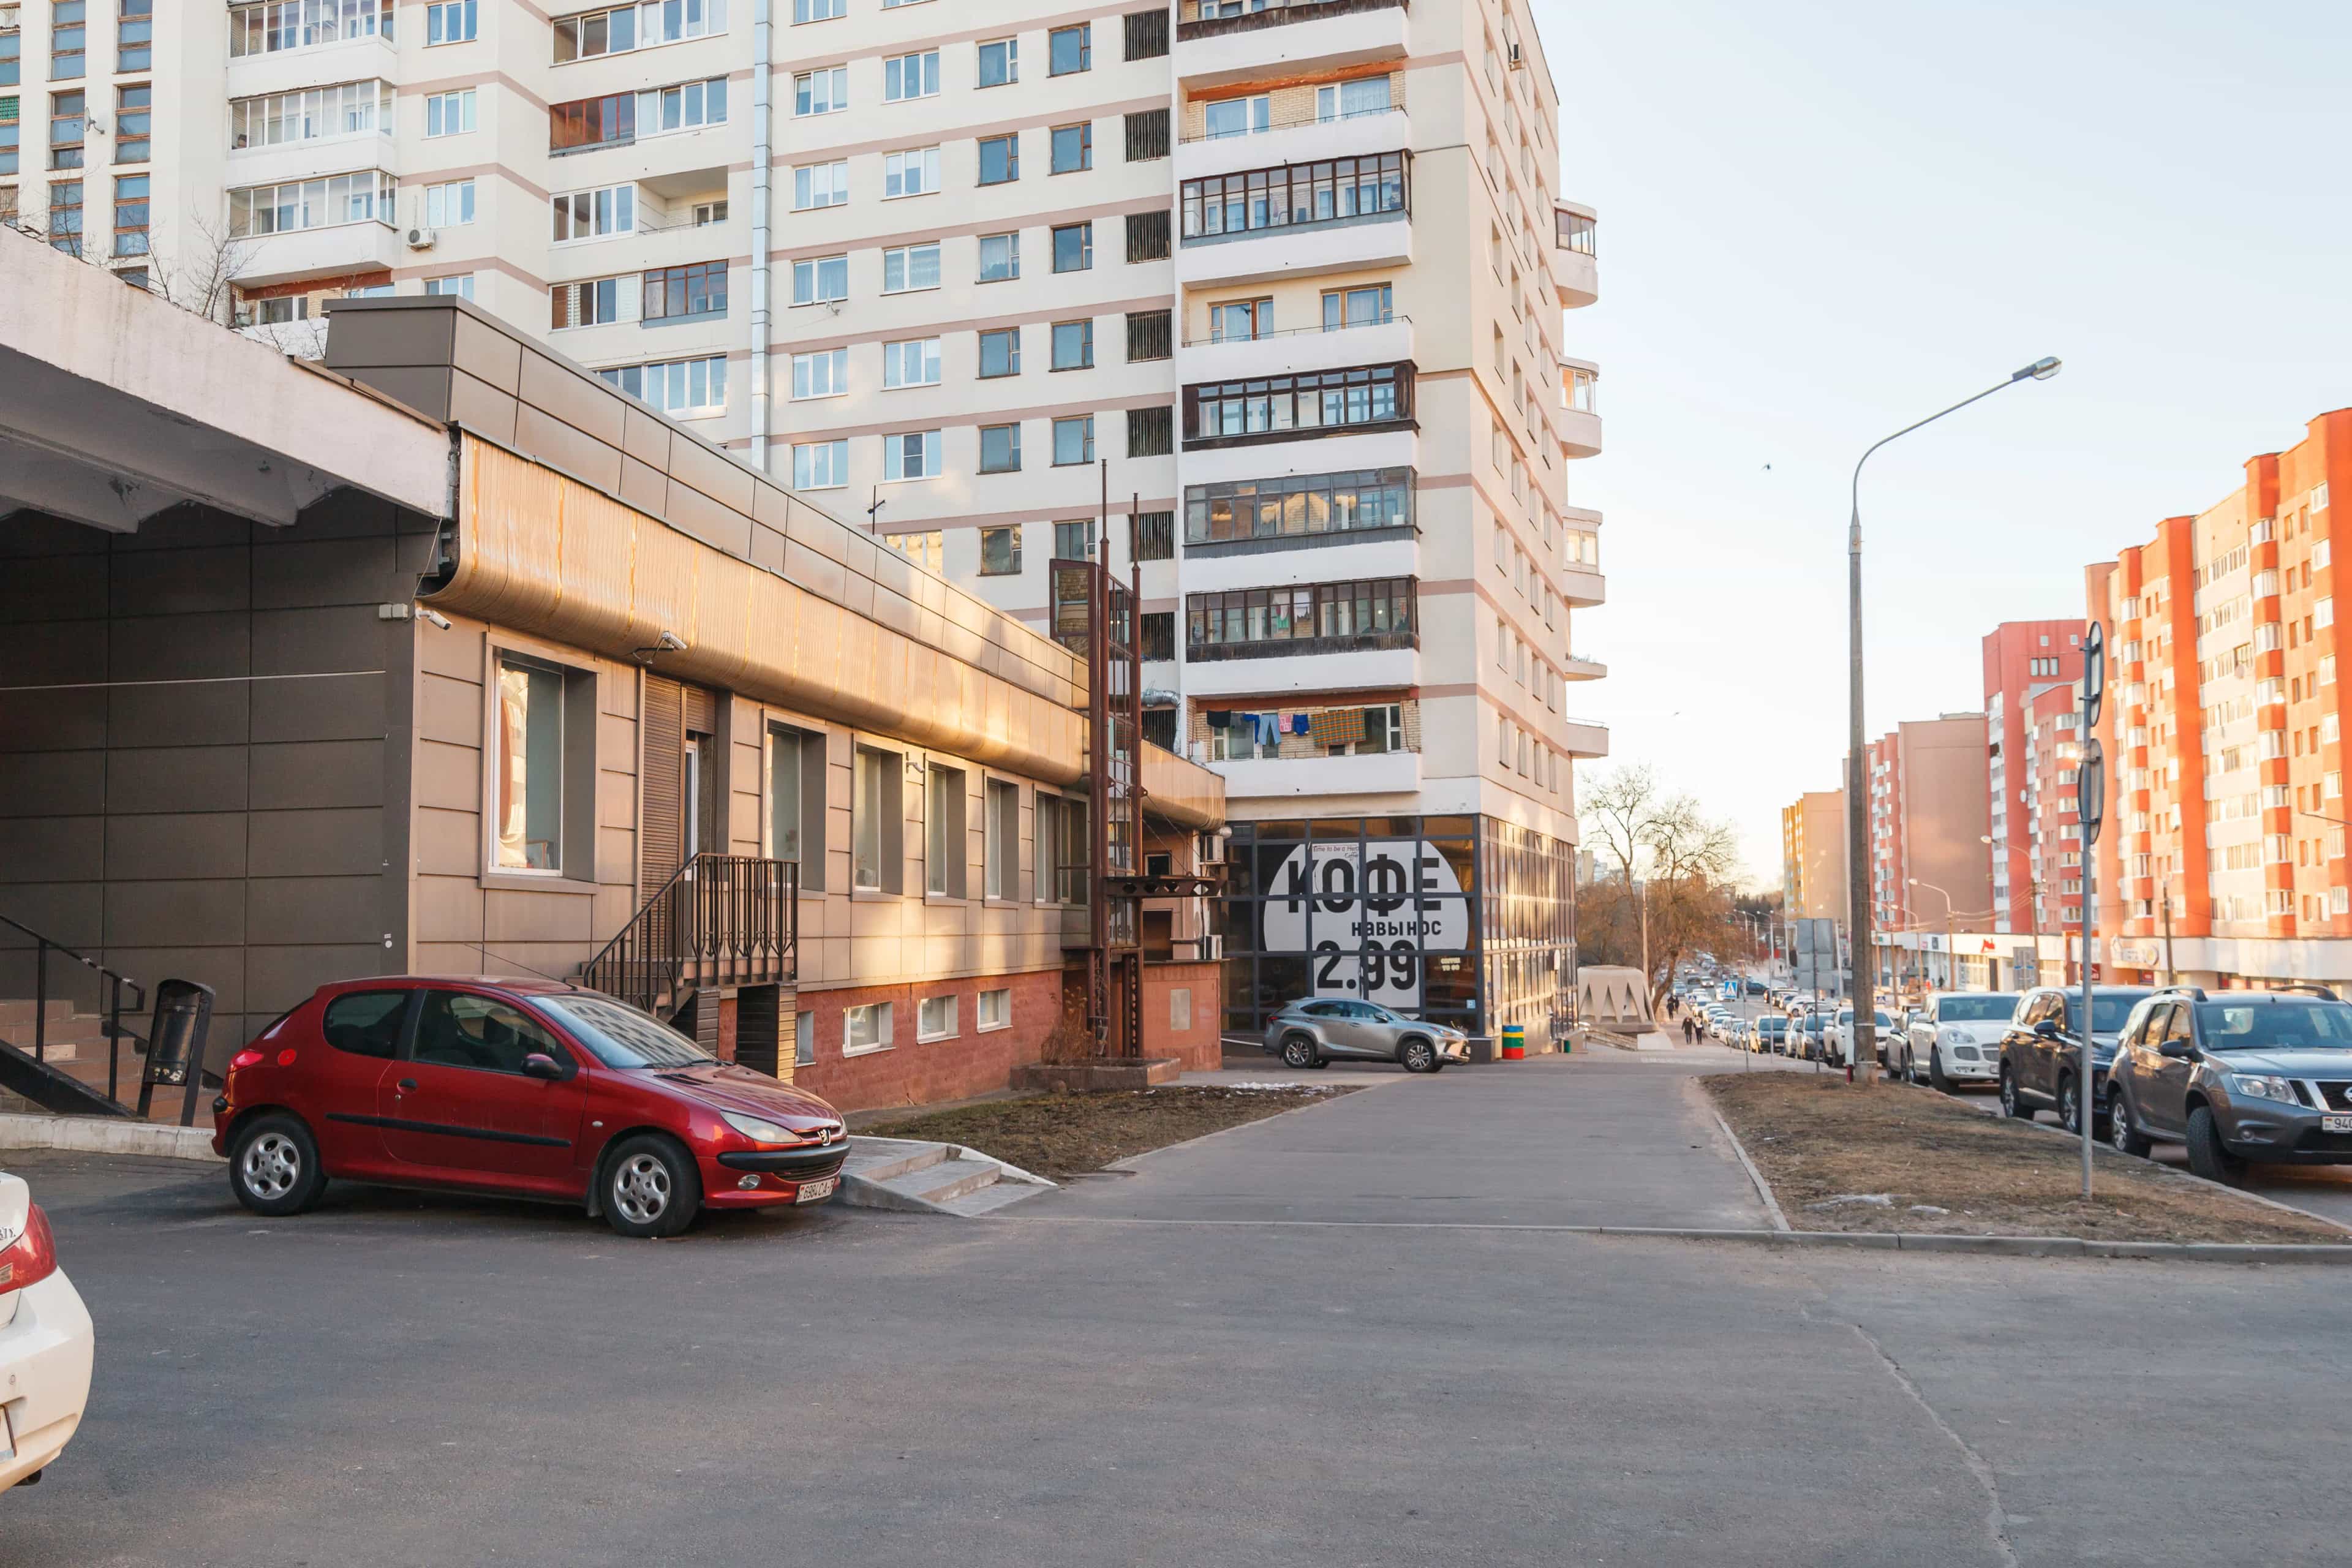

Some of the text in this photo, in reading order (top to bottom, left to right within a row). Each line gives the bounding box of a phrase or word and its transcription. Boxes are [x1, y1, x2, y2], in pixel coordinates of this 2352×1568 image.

[1288, 854, 1441, 916] КОФЕ
[1352, 921, 1441, 936] навынос
[1316, 940, 1416, 990] 2.99
